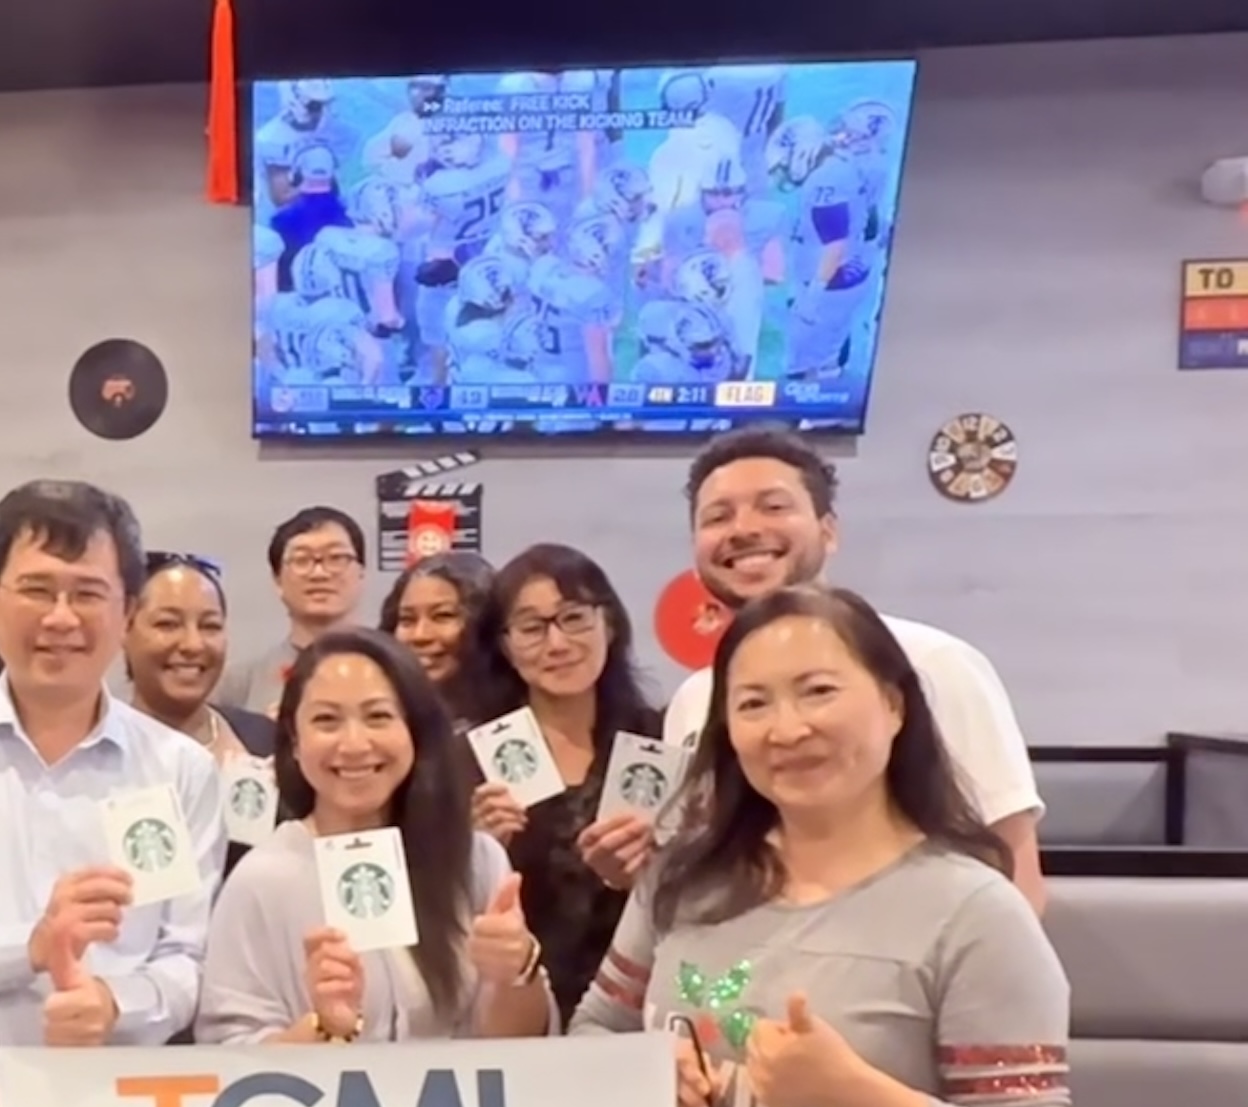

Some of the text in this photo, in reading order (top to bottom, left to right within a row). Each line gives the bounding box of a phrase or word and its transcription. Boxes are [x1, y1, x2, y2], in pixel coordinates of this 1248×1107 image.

[511, 96, 549, 111] FREE
[553, 94, 590, 110] KICK
[518, 115, 541, 131] ON
[545, 114, 577, 130] THE
[579, 112, 644, 129] KICKING
[677, 386, 707, 403] 2:11
[725, 385, 765, 402] FLAG
